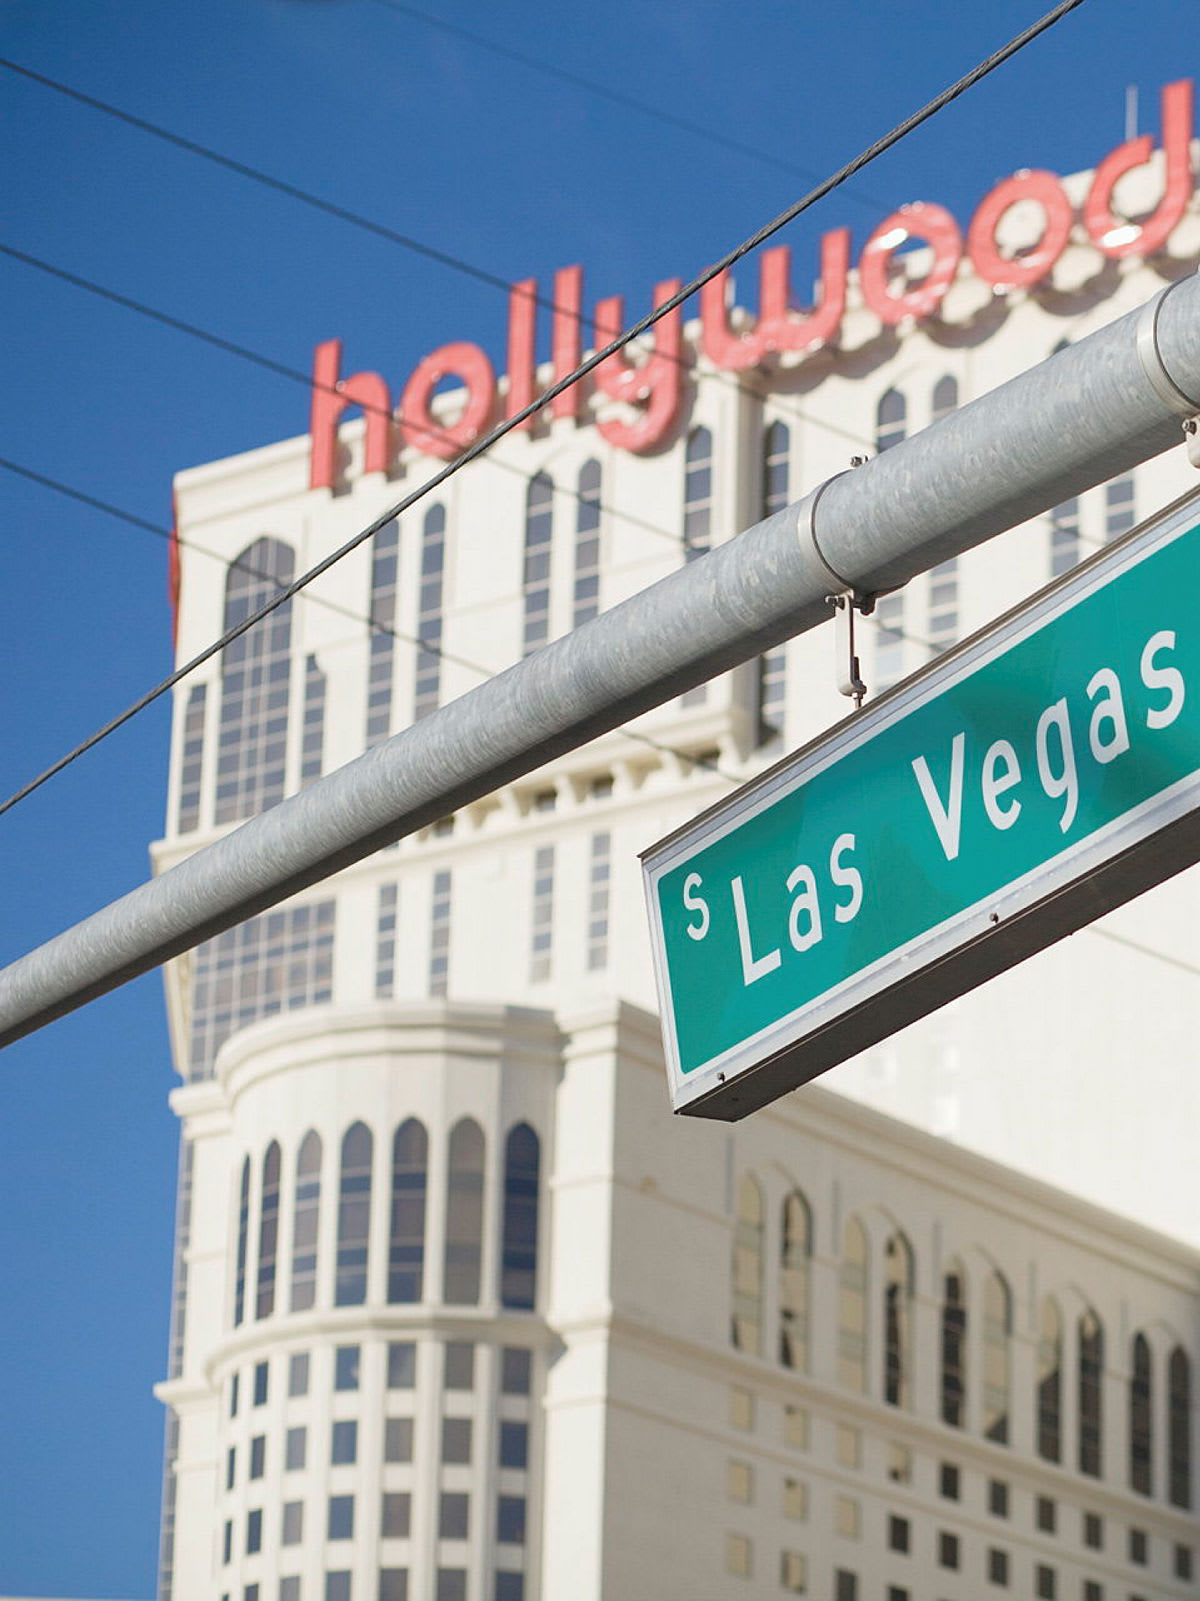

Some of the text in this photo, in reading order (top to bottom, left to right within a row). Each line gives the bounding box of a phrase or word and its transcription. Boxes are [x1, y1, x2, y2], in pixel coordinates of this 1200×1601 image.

[309, 79, 1195, 491] hollywood
[683, 872, 711, 941] S
[731, 833, 864, 986] Las
[911, 630, 1186, 861] Vegas
